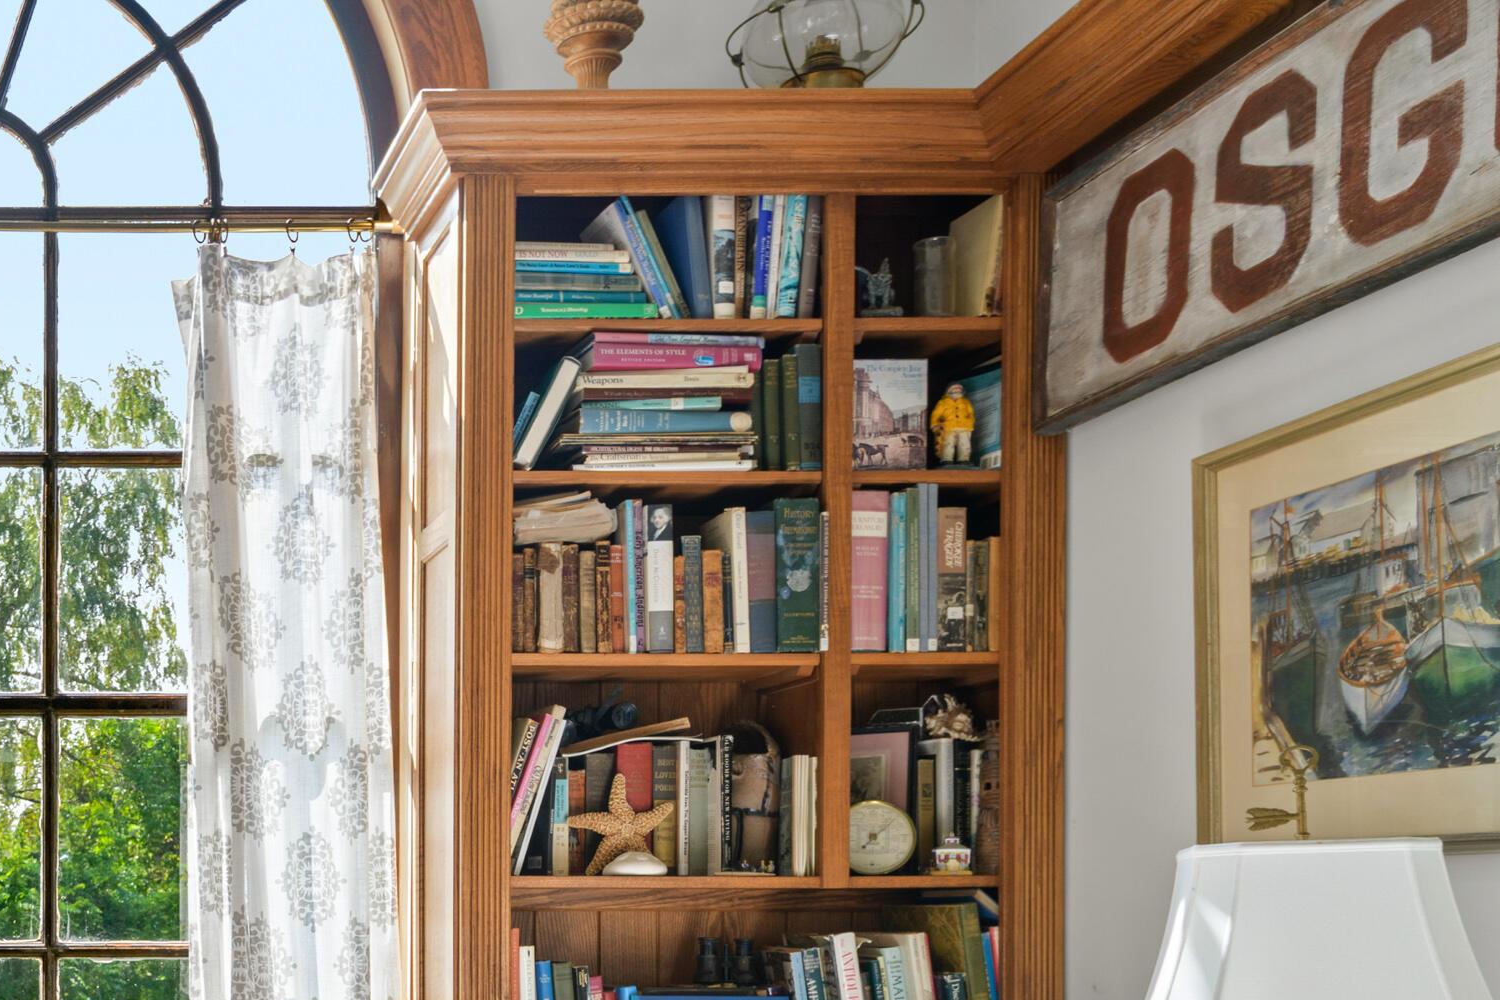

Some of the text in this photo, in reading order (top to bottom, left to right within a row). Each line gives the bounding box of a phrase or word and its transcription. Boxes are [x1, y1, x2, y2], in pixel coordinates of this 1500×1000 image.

[1102, 0, 1500, 364] OSG
[547, 250, 568, 258] NOW
[582, 376, 624, 386] Weapons
[635, 530, 644, 550] Early
[943, 527, 954, 568] TRAGEDY
[954, 521, 964, 567] CHEROKEE
[635, 553, 644, 590] American
[521, 725, 537, 751] POST
